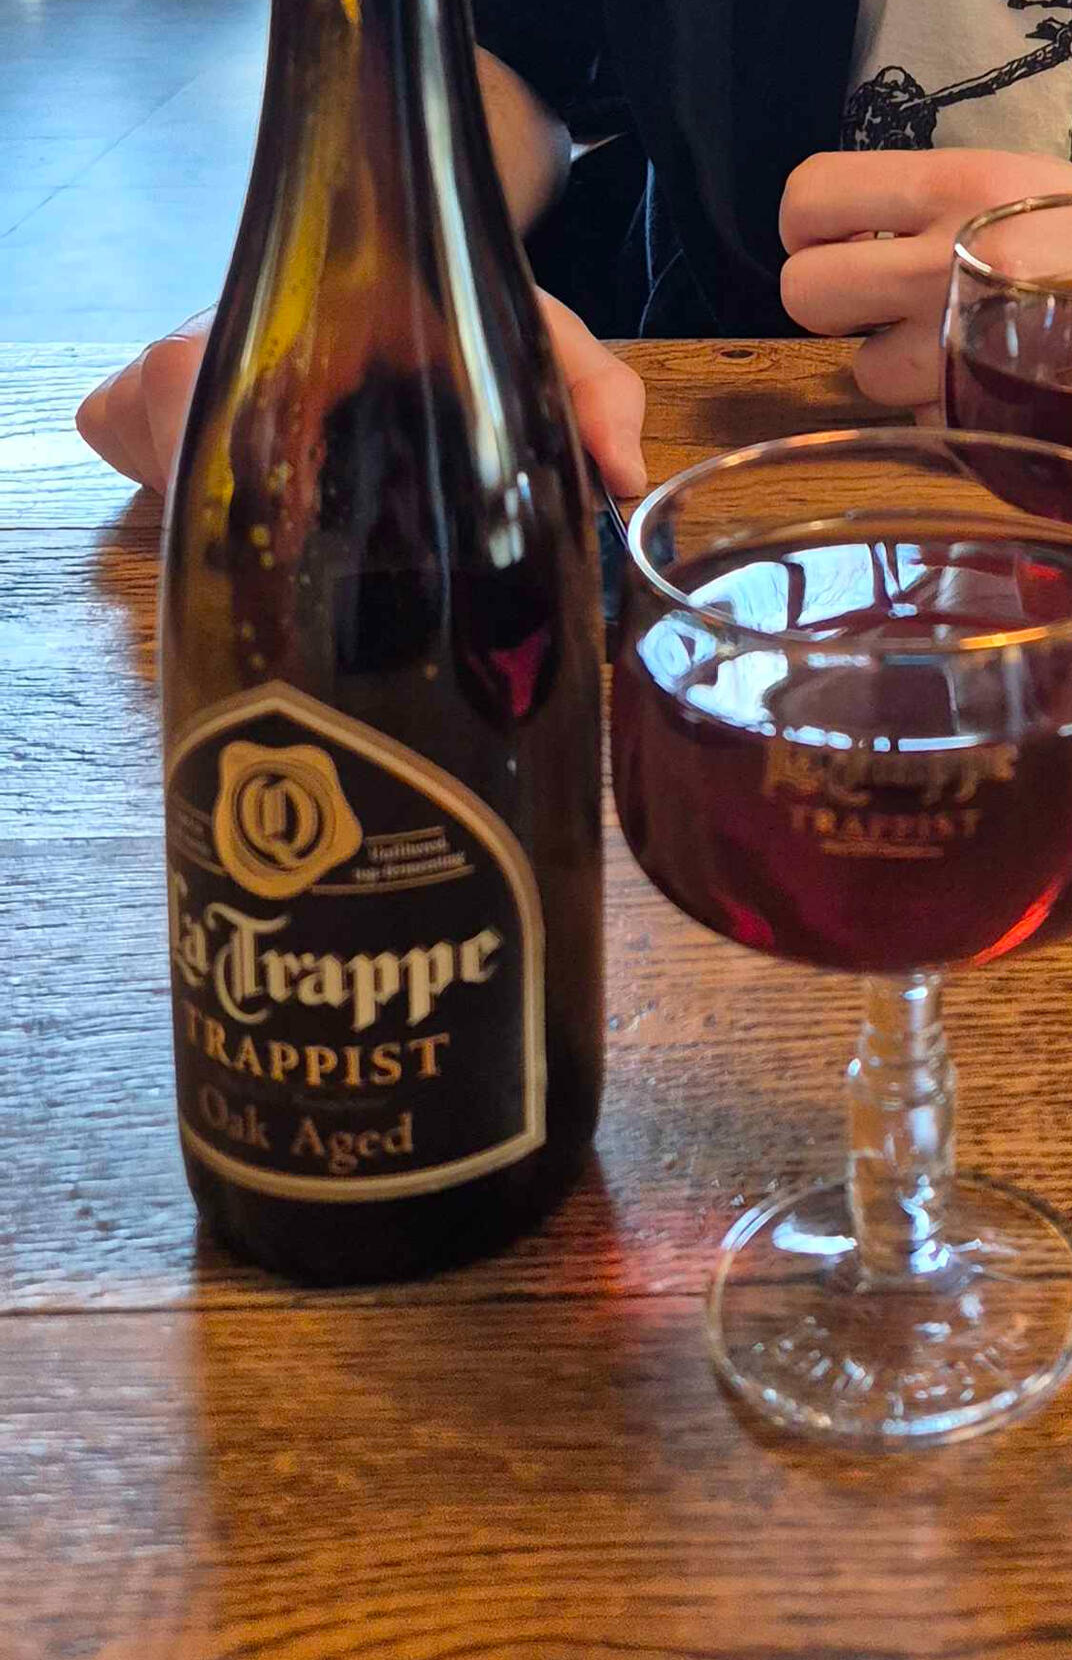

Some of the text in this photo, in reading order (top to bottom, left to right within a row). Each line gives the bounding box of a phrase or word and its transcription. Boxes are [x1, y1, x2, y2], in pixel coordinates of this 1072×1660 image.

[204, 901, 502, 1033] Trappe
[182, 1000, 451, 1088] TRAPPIST
[200, 1083, 414, 1175] Oak Aged
